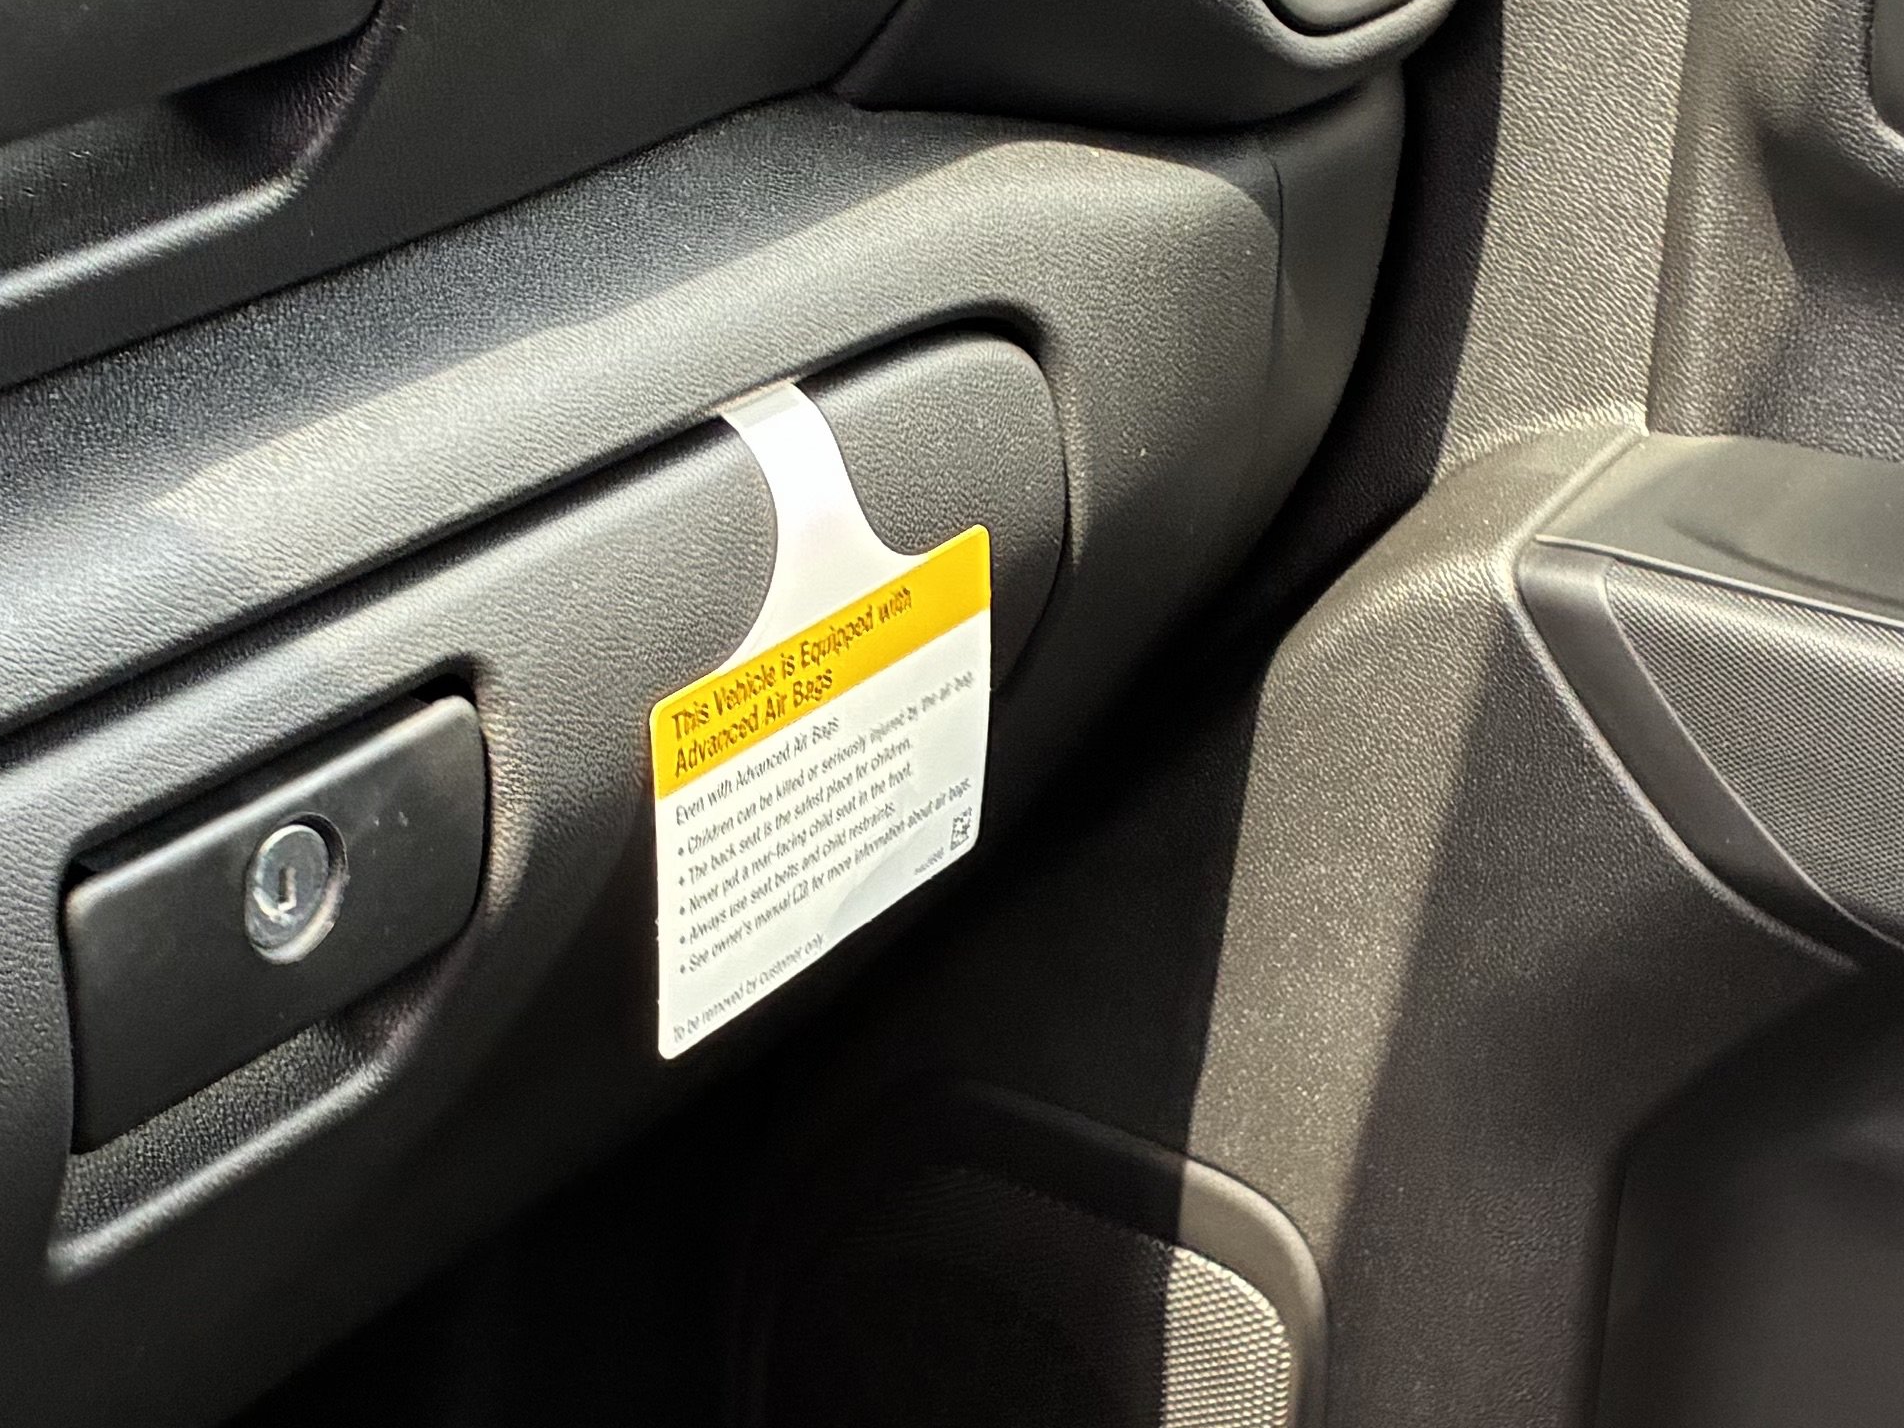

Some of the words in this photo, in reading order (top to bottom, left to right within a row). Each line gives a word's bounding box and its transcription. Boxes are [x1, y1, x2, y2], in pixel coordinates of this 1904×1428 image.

[672, 701, 710, 742] This
[713, 664, 777, 716] Vehicle
[780, 652, 796, 679] is
[800, 604, 874, 668] Equipped
[878, 585, 913, 623] with
[675, 704, 760, 778] Advanced
[764, 691, 787, 727] Air
[792, 668, 834, 708] Bags
[675, 796, 705, 826] Even
[707, 778, 733, 806] with
[736, 741, 791, 791] Advanced
[793, 732, 808, 758] Air
[811, 717, 840, 746] Bags
[688, 817, 735, 855] Children
[736, 802, 757, 825] can
[759, 792, 774, 811] be
[775, 768, 805, 802] killed
[807, 763, 819, 782] or
[821, 735, 867, 774] seriously
[688, 861, 708, 885] The
[710, 842, 737, 871] back
[739, 825, 762, 854] seat
[763, 820, 773, 840] is
[775, 809, 792, 831] the
[794, 785, 825, 820] safest
[826, 772, 854, 803] place
[855, 761, 869, 781] for
[689, 883, 719, 915] Never
[722, 867, 740, 897] put
[741, 865, 750, 881] a
[751, 828, 807, 876] rear-facing
[809, 808, 834, 838] child
[836, 795, 857, 822] seat
[858, 789, 868, 808] in
[870, 779, 886, 801] the
[689, 948, 710, 973] See
[711, 919, 754, 958] owner's
[754, 890, 792, 930] manual
[811, 872, 825, 893] for
[827, 855, 852, 883] more
[854, 819, 906, 865] information
[907, 799, 934, 829] about
[934, 791, 947, 811] air
[689, 909, 727, 945] Always
[729, 894, 748, 918] use
[750, 875, 773, 905] seat
[774, 861, 800, 889] belts
[801, 844, 821, 872] and
[822, 827, 847, 858] child
[672, 1024, 686, 1044] To
[687, 1015, 700, 1035] be
[701, 982, 745, 1025] removed
[745, 976, 758, 997] by
[759, 945, 803, 985] customer
